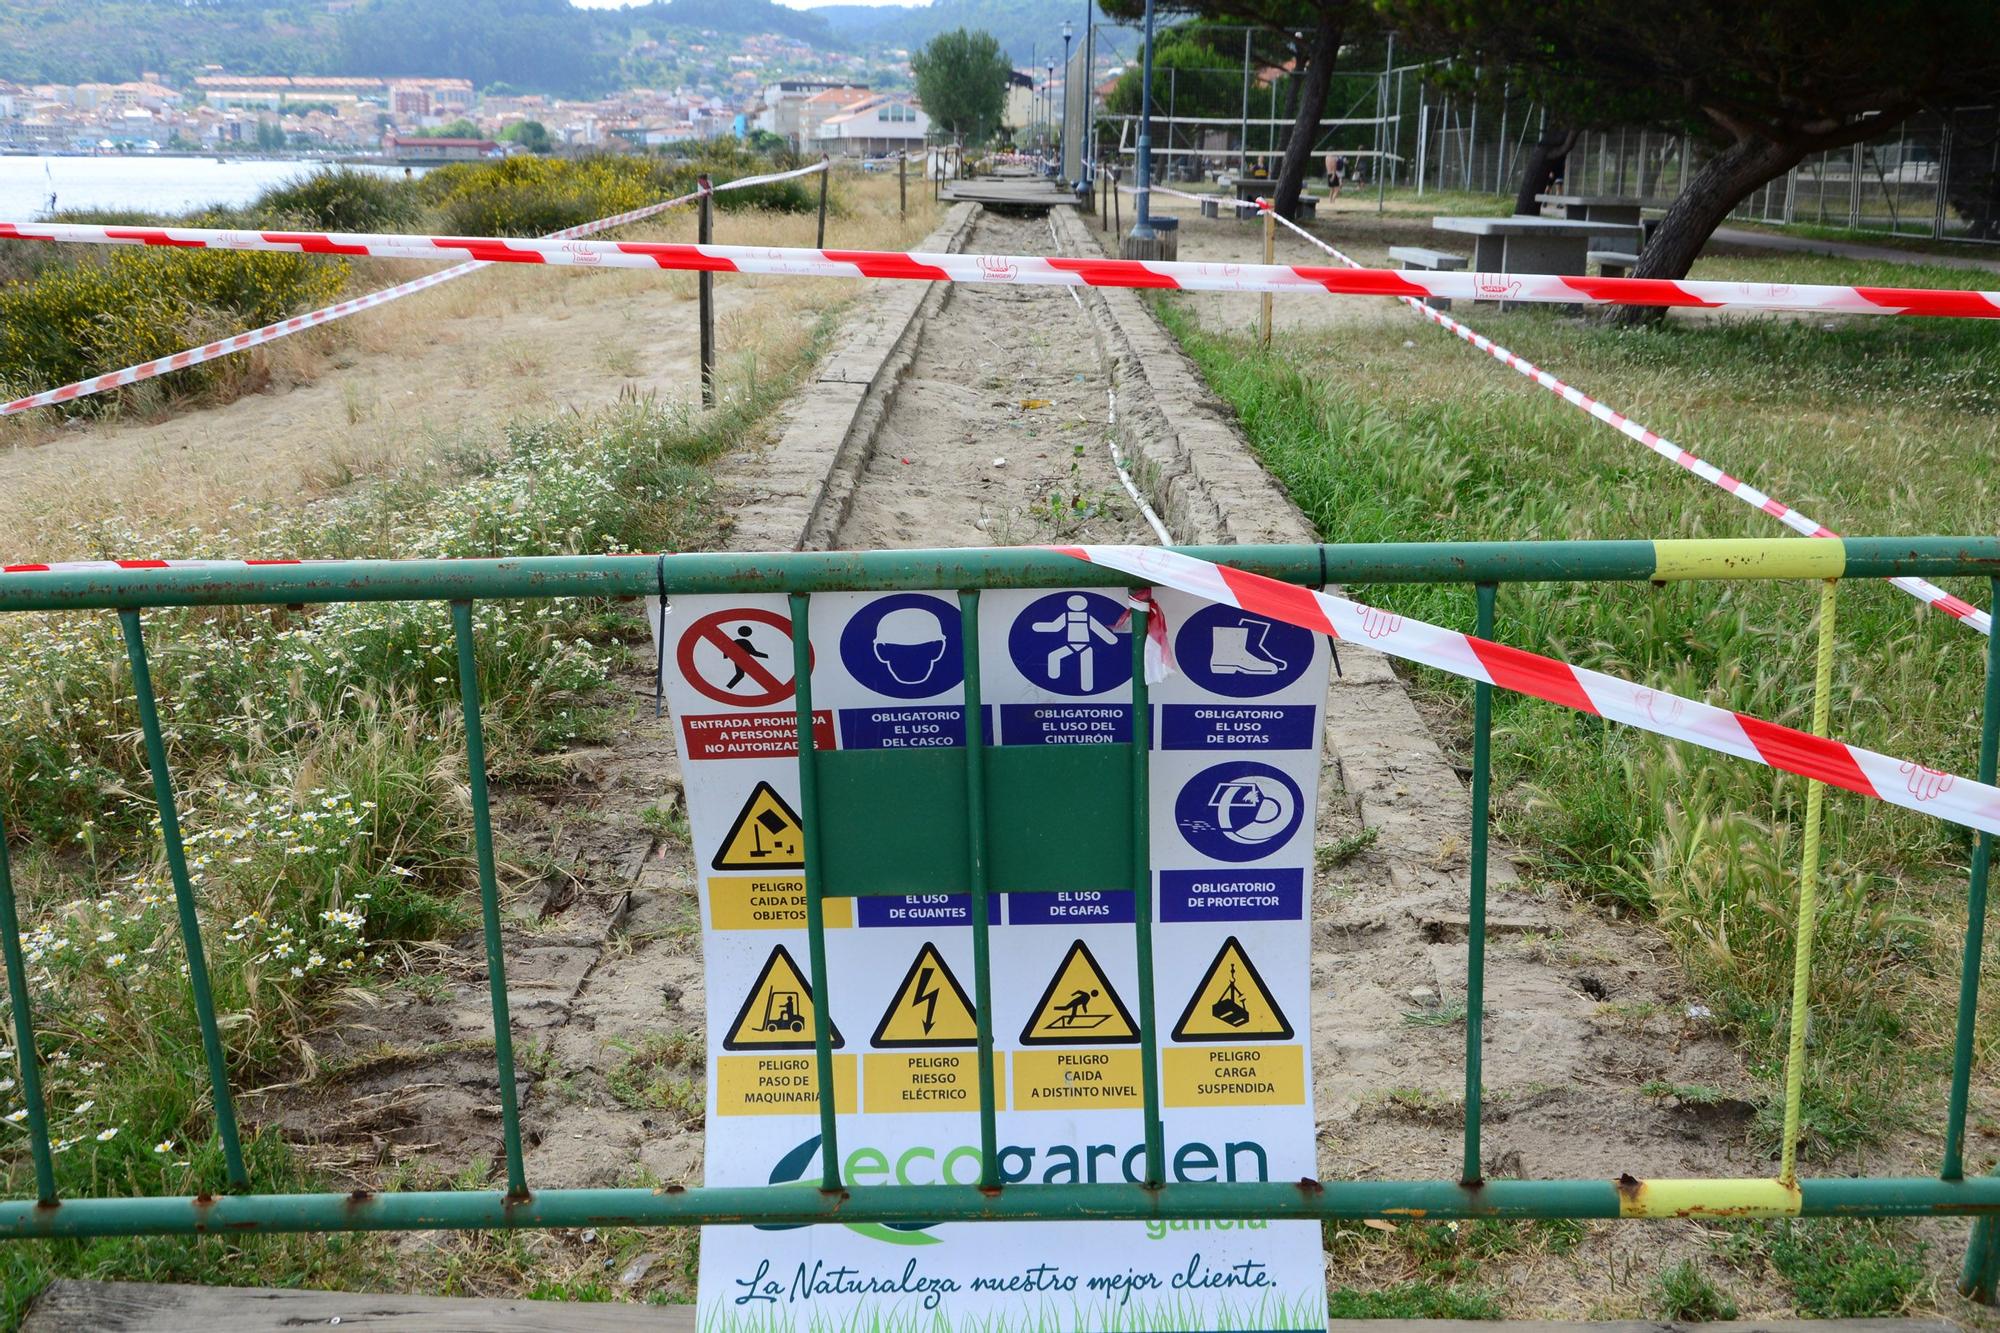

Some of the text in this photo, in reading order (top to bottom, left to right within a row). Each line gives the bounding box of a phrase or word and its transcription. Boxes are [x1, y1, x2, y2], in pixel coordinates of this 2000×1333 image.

[871, 711, 960, 722] OBLIGATORIO
[1034, 709, 1124, 719] OBLIGATORIO
[1194, 709, 1284, 720] OBLIGATORIO
[690, 718, 751, 729] ENTRADA
[894, 724, 940, 734] EL USO
[1042, 721, 1116, 731] EL USO DEL
[1216, 722, 1262, 732] EL USO
[719, 730, 728, 740] A
[1045, 732, 1113, 744] CINTURÓN
[1206, 734, 1270, 744] DE BOTAS
[882, 736, 954, 747] DEL CASCO
[705, 743, 725, 753] NO
[752, 882, 803, 892] PELIGRO
[1192, 882, 1276, 893] OBLIGATORIO
[750, 896, 807, 907] CAIDA DE
[906, 894, 949, 904] EL USO
[1058, 891, 1101, 901] EL USO
[1188, 895, 1280, 907] DE PROTECTOR
[753, 910, 807, 921] OBJETOS
[889, 908, 967, 919] DE GUANTES
[1050, 905, 1110, 916] DE GAFAS
[1057, 1054, 1109, 1066] PELIGRO
[1209, 1051, 1261, 1062] PELIGRO
[759, 1060, 810, 1071] PELIGRO
[908, 1057, 960, 1068] PELIGRO
[1064, 1070, 1103, 1082] CAIDA
[1215, 1067, 1256, 1078] CARGA
[759, 1075, 809, 1087] PASO DE
[912, 1073, 956, 1084] RIESGO
[902, 1087, 967, 1100] ELÉCTRICO
[1031, 1086, 1137, 1098] A DISTINTO NIVEL
[1197, 1082, 1275, 1095] SUSPENDIDA
[734, 1253, 1278, 1310] La Naturaleza nuestro mejor cliente.
